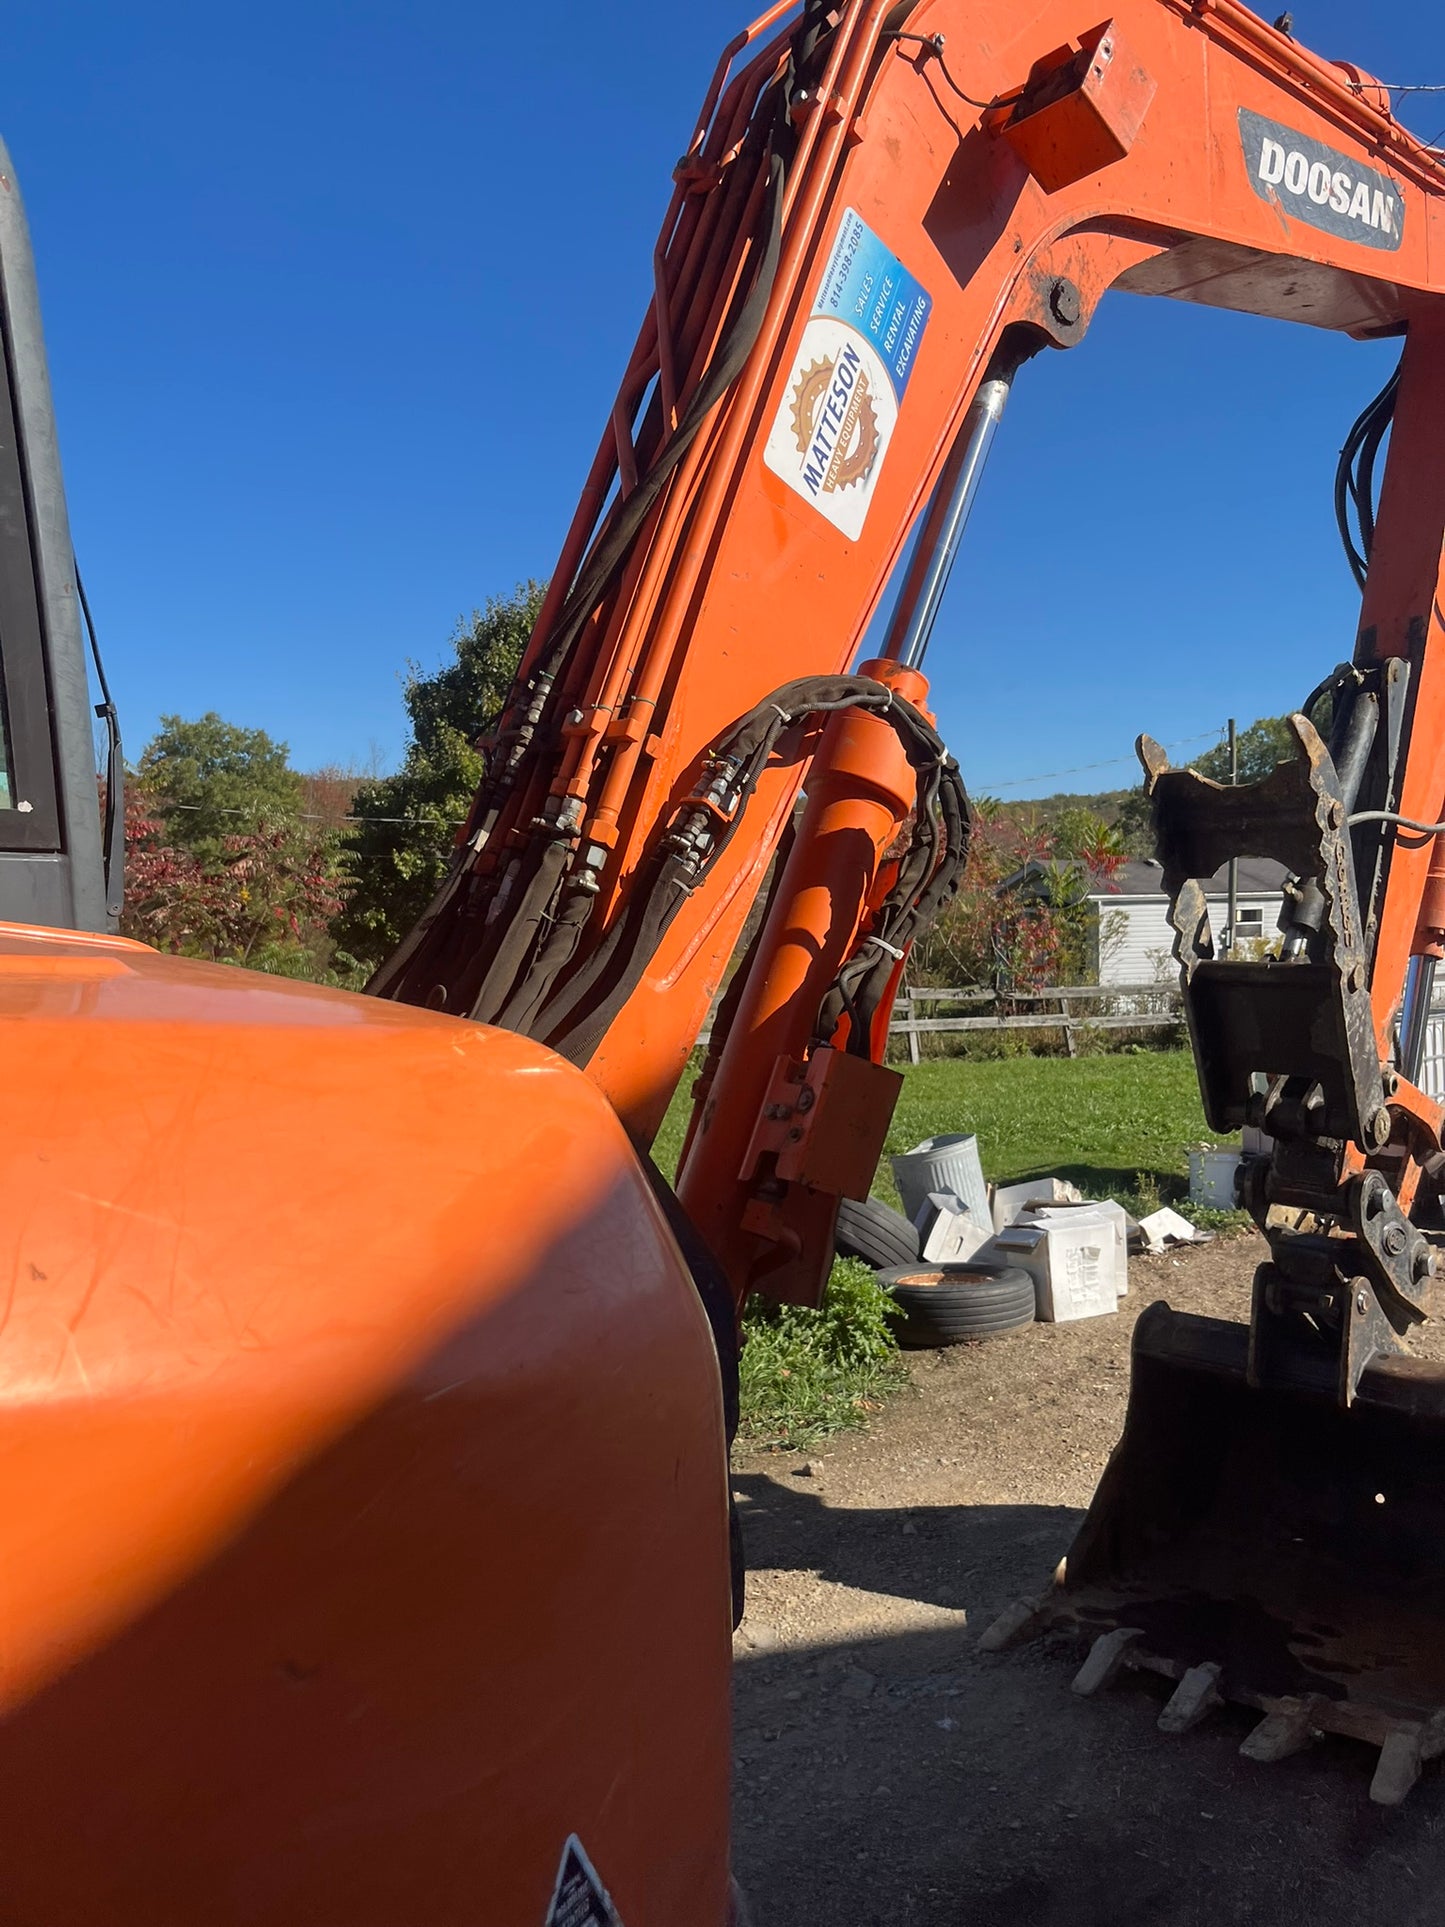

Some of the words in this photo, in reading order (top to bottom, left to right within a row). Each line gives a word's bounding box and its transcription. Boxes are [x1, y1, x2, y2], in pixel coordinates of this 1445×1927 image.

[1258, 137, 1395, 234] DOOSAN
[830, 222, 864, 308] 814-398-2085
[854, 271, 875, 317] SALES
[870, 275, 894, 334] SERVICE
[883, 301, 906, 353] RENTAL
[895, 296, 927, 378] EXCAVATING
[803, 343, 861, 496] MATTESON
[826, 447, 844, 489] HEAVY
[839, 377, 867, 447] EQUIPMENT
